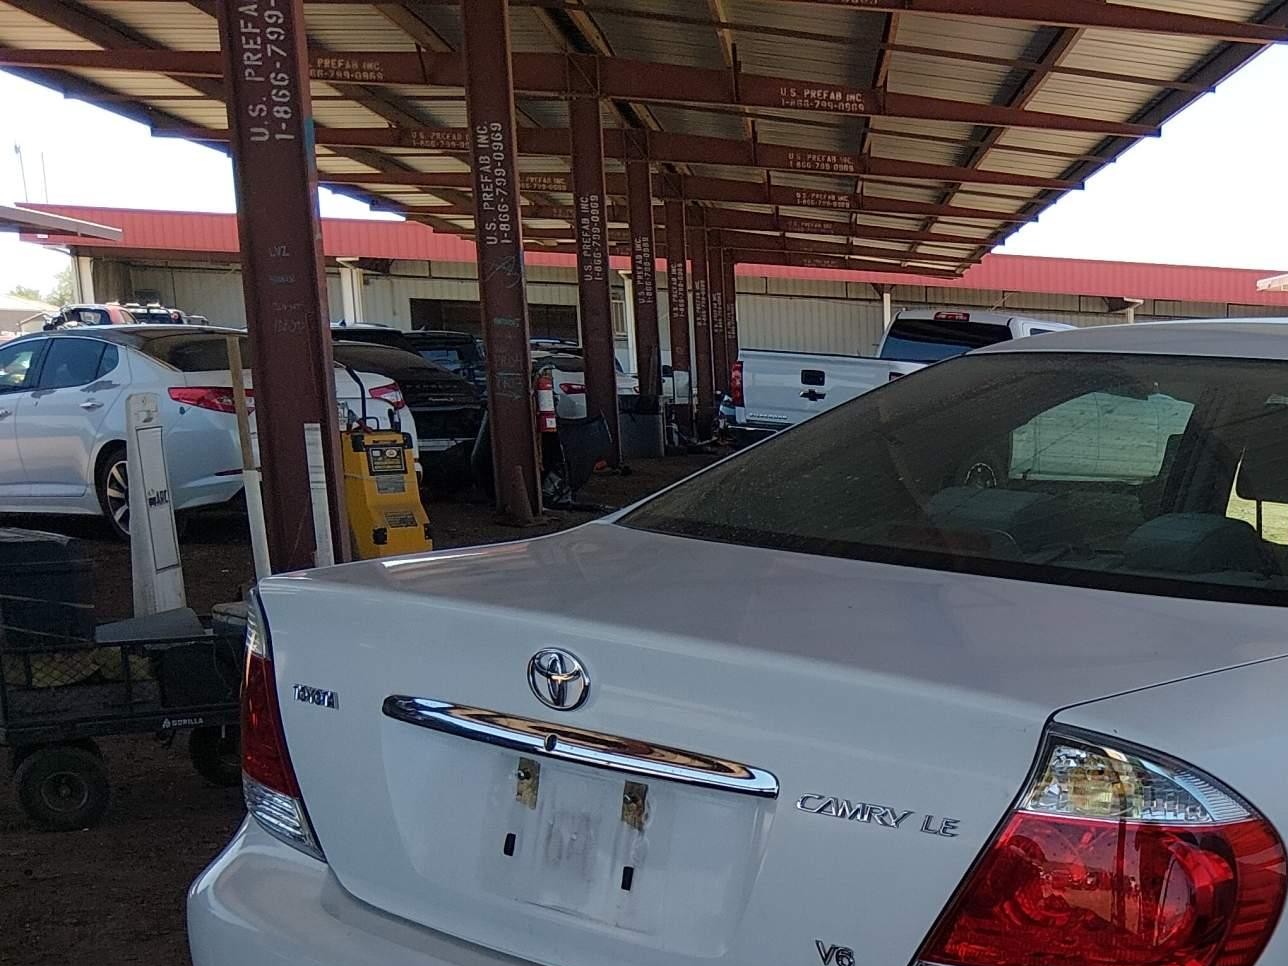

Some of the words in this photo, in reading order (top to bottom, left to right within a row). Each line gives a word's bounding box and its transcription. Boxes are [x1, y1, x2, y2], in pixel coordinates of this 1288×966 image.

[238, 3, 265, 81] PREFA
[264, 0, 295, 140] 1-866-799-
[803, 88, 842, 101] PREFAB
[248, 97, 270, 141] U.S.
[478, 155, 495, 210] PREFAB
[490, 122, 512, 244] 1-866-799-0969
[293, 683, 339, 710] TOYOTA
[171, 717, 204, 727] GORILLA
[796, 792, 915, 829] CAMRY
[920, 815, 961, 838] LE
